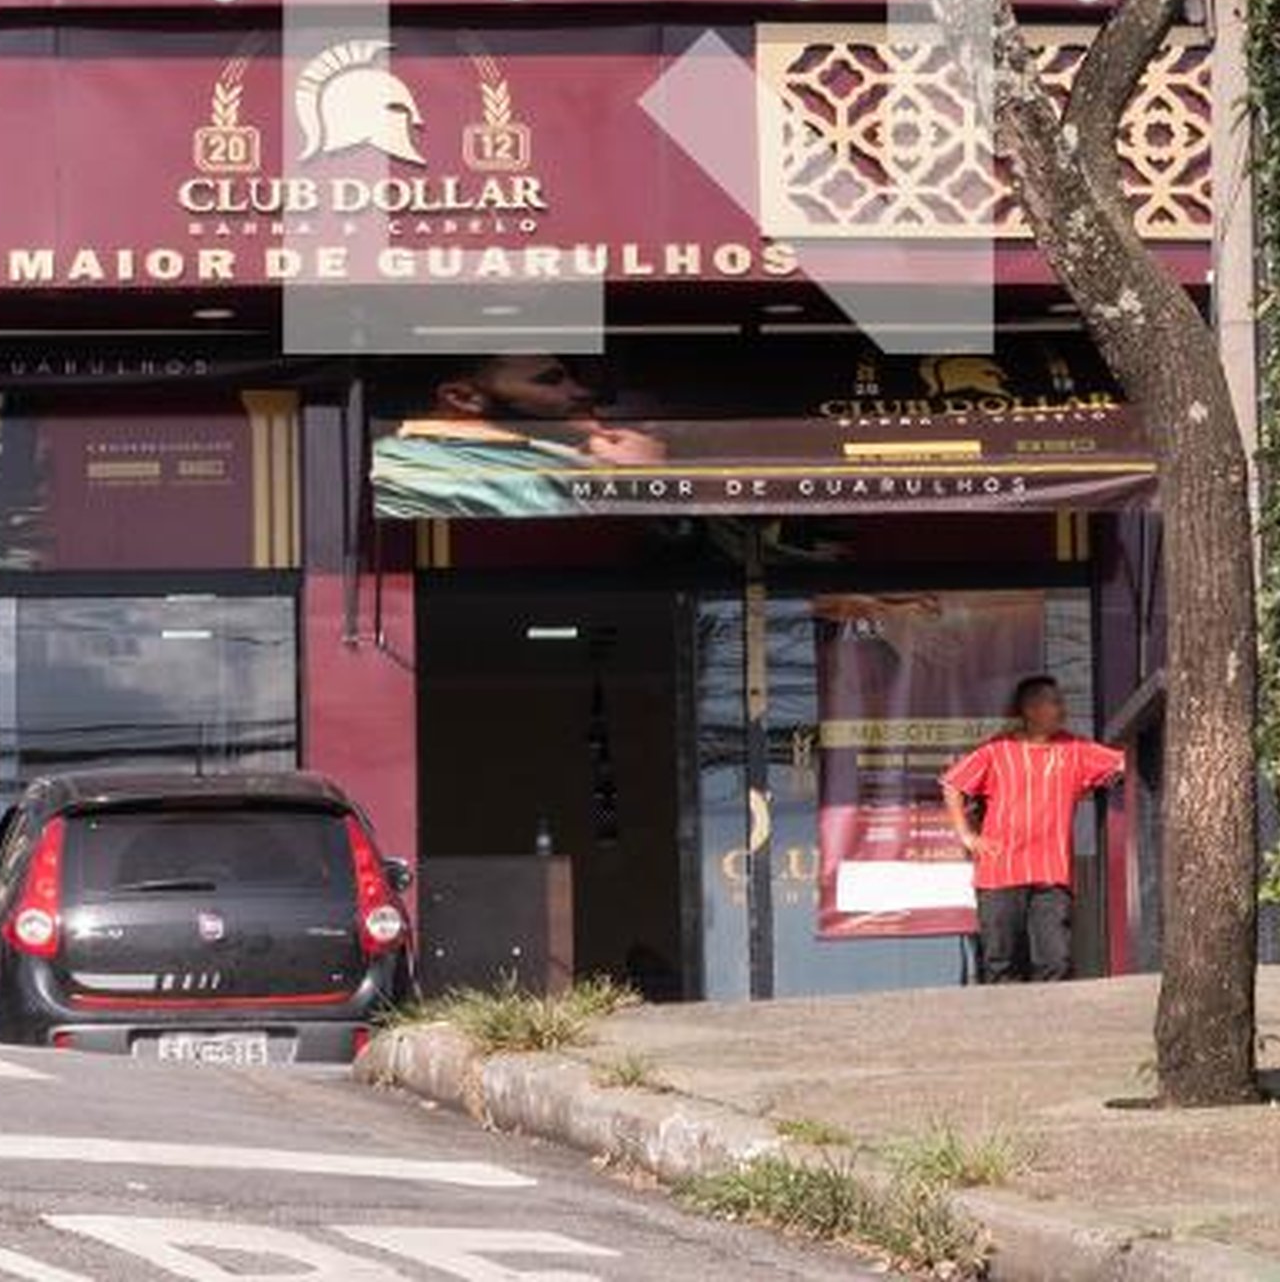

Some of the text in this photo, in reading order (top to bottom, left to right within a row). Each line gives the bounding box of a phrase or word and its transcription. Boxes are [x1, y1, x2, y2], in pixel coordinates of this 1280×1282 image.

[208, 136, 246, 161] 20
[480, 134, 514, 159] 12
[178, 176, 548, 213] CLUB DOLLAR
[8, 247, 238, 282] MAIOR
[264, 246, 351, 281] DE
[377, 241, 799, 280] GUARULHOS
[571, 476, 1026, 497] MAIOR DE GUARULHOS
